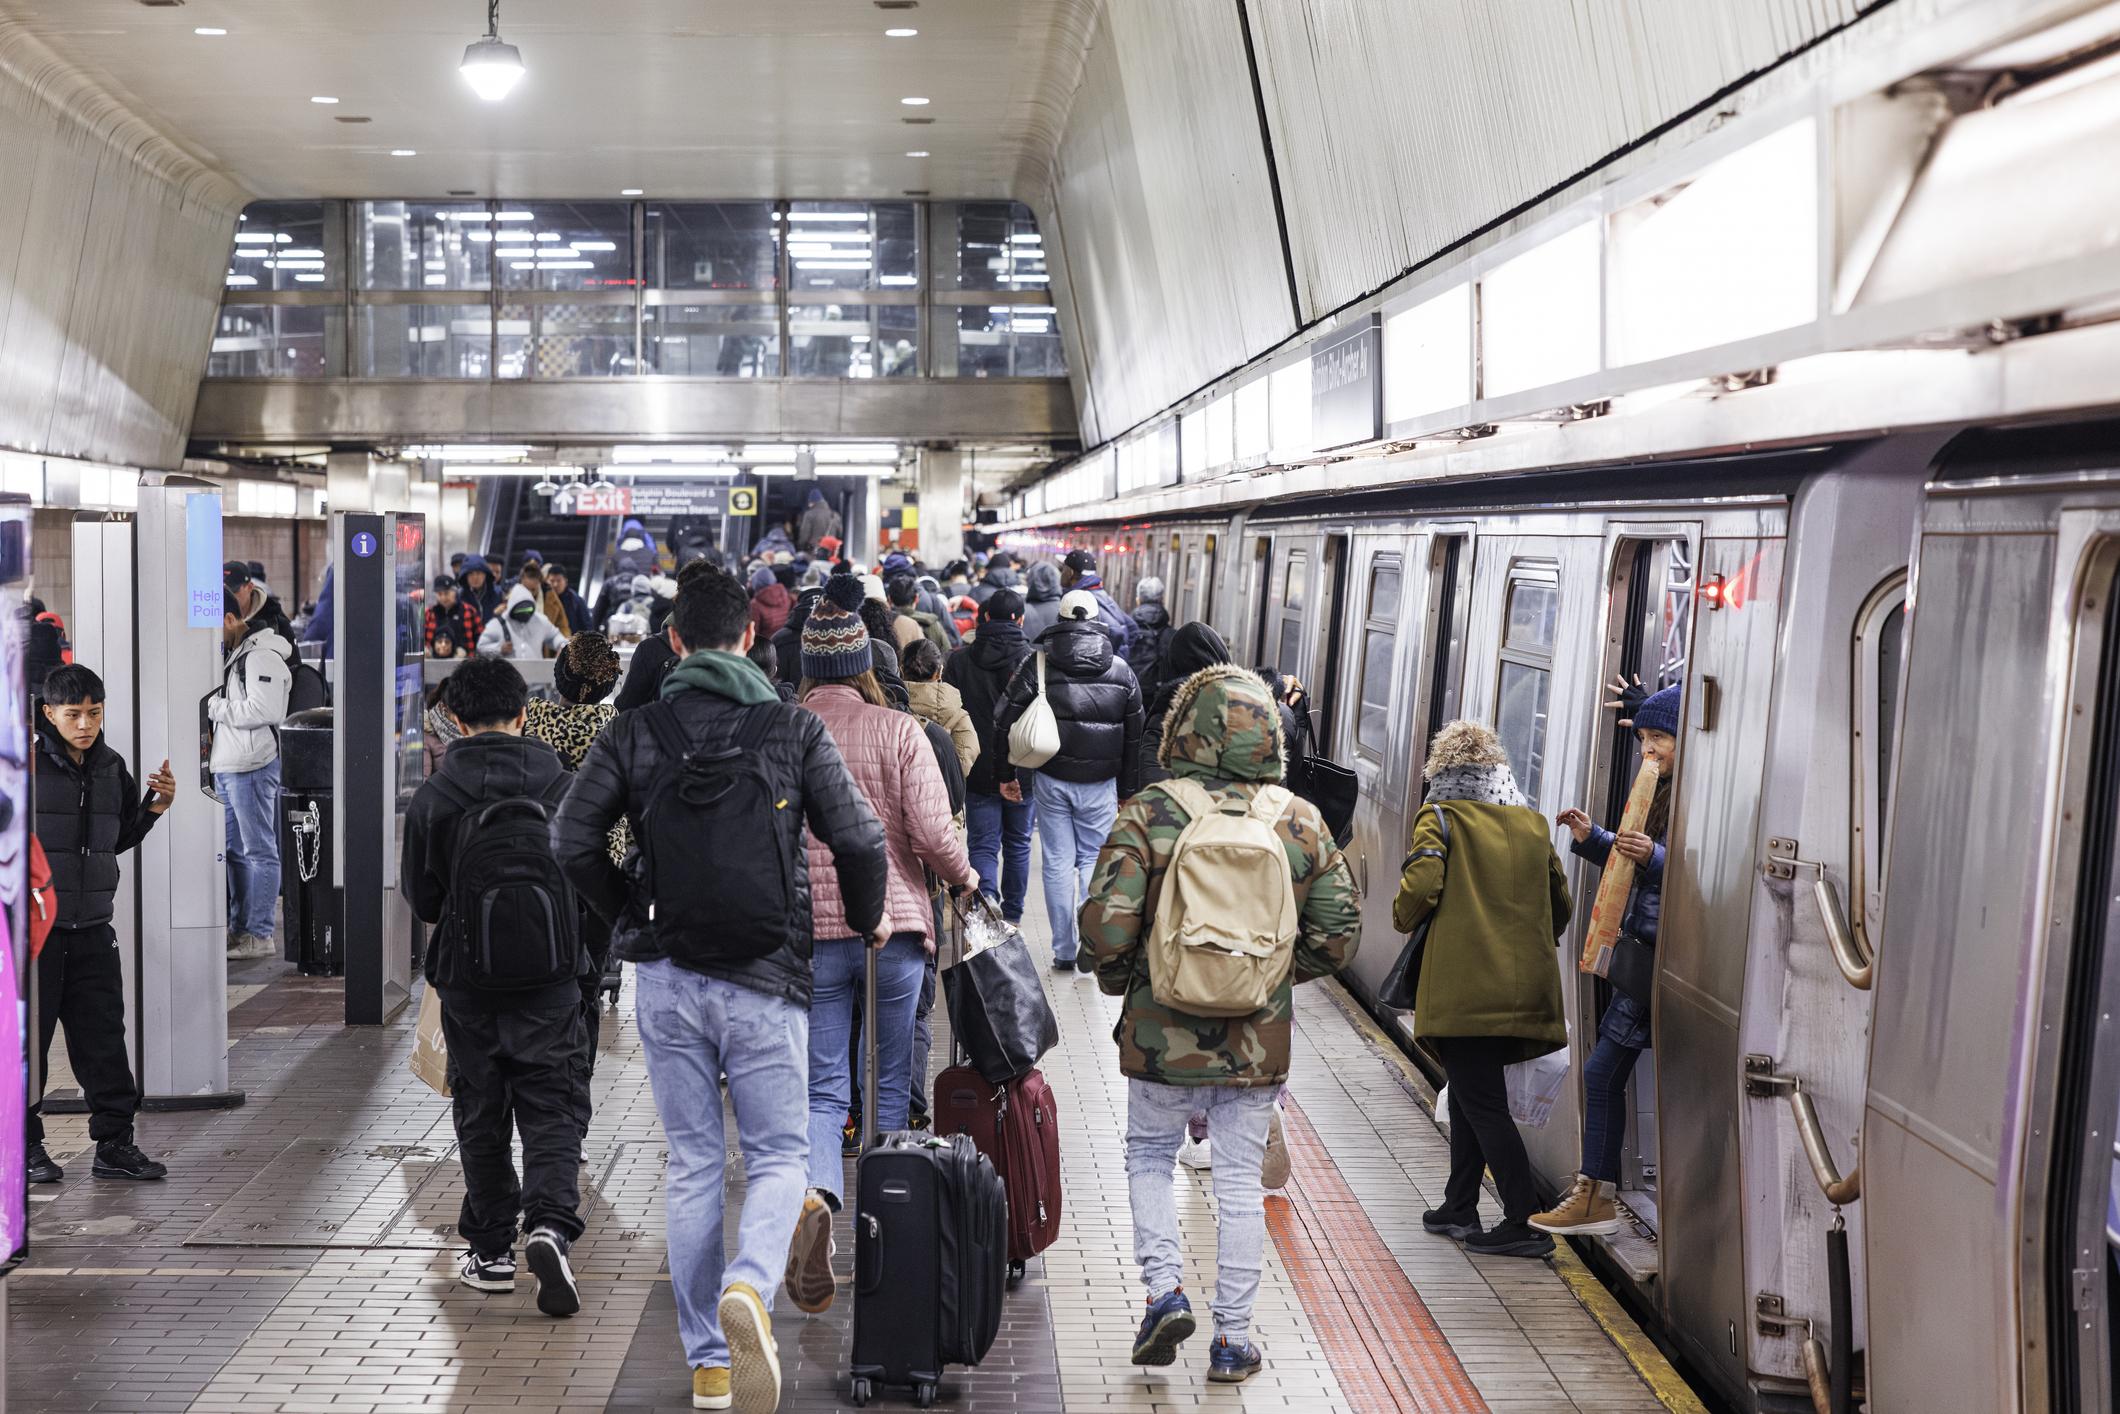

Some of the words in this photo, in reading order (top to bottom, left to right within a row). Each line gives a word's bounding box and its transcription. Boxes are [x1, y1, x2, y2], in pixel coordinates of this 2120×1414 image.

[577, 488, 625, 511] Exit
[193, 590, 221, 604] Help
[193, 604, 224, 617] Poin
